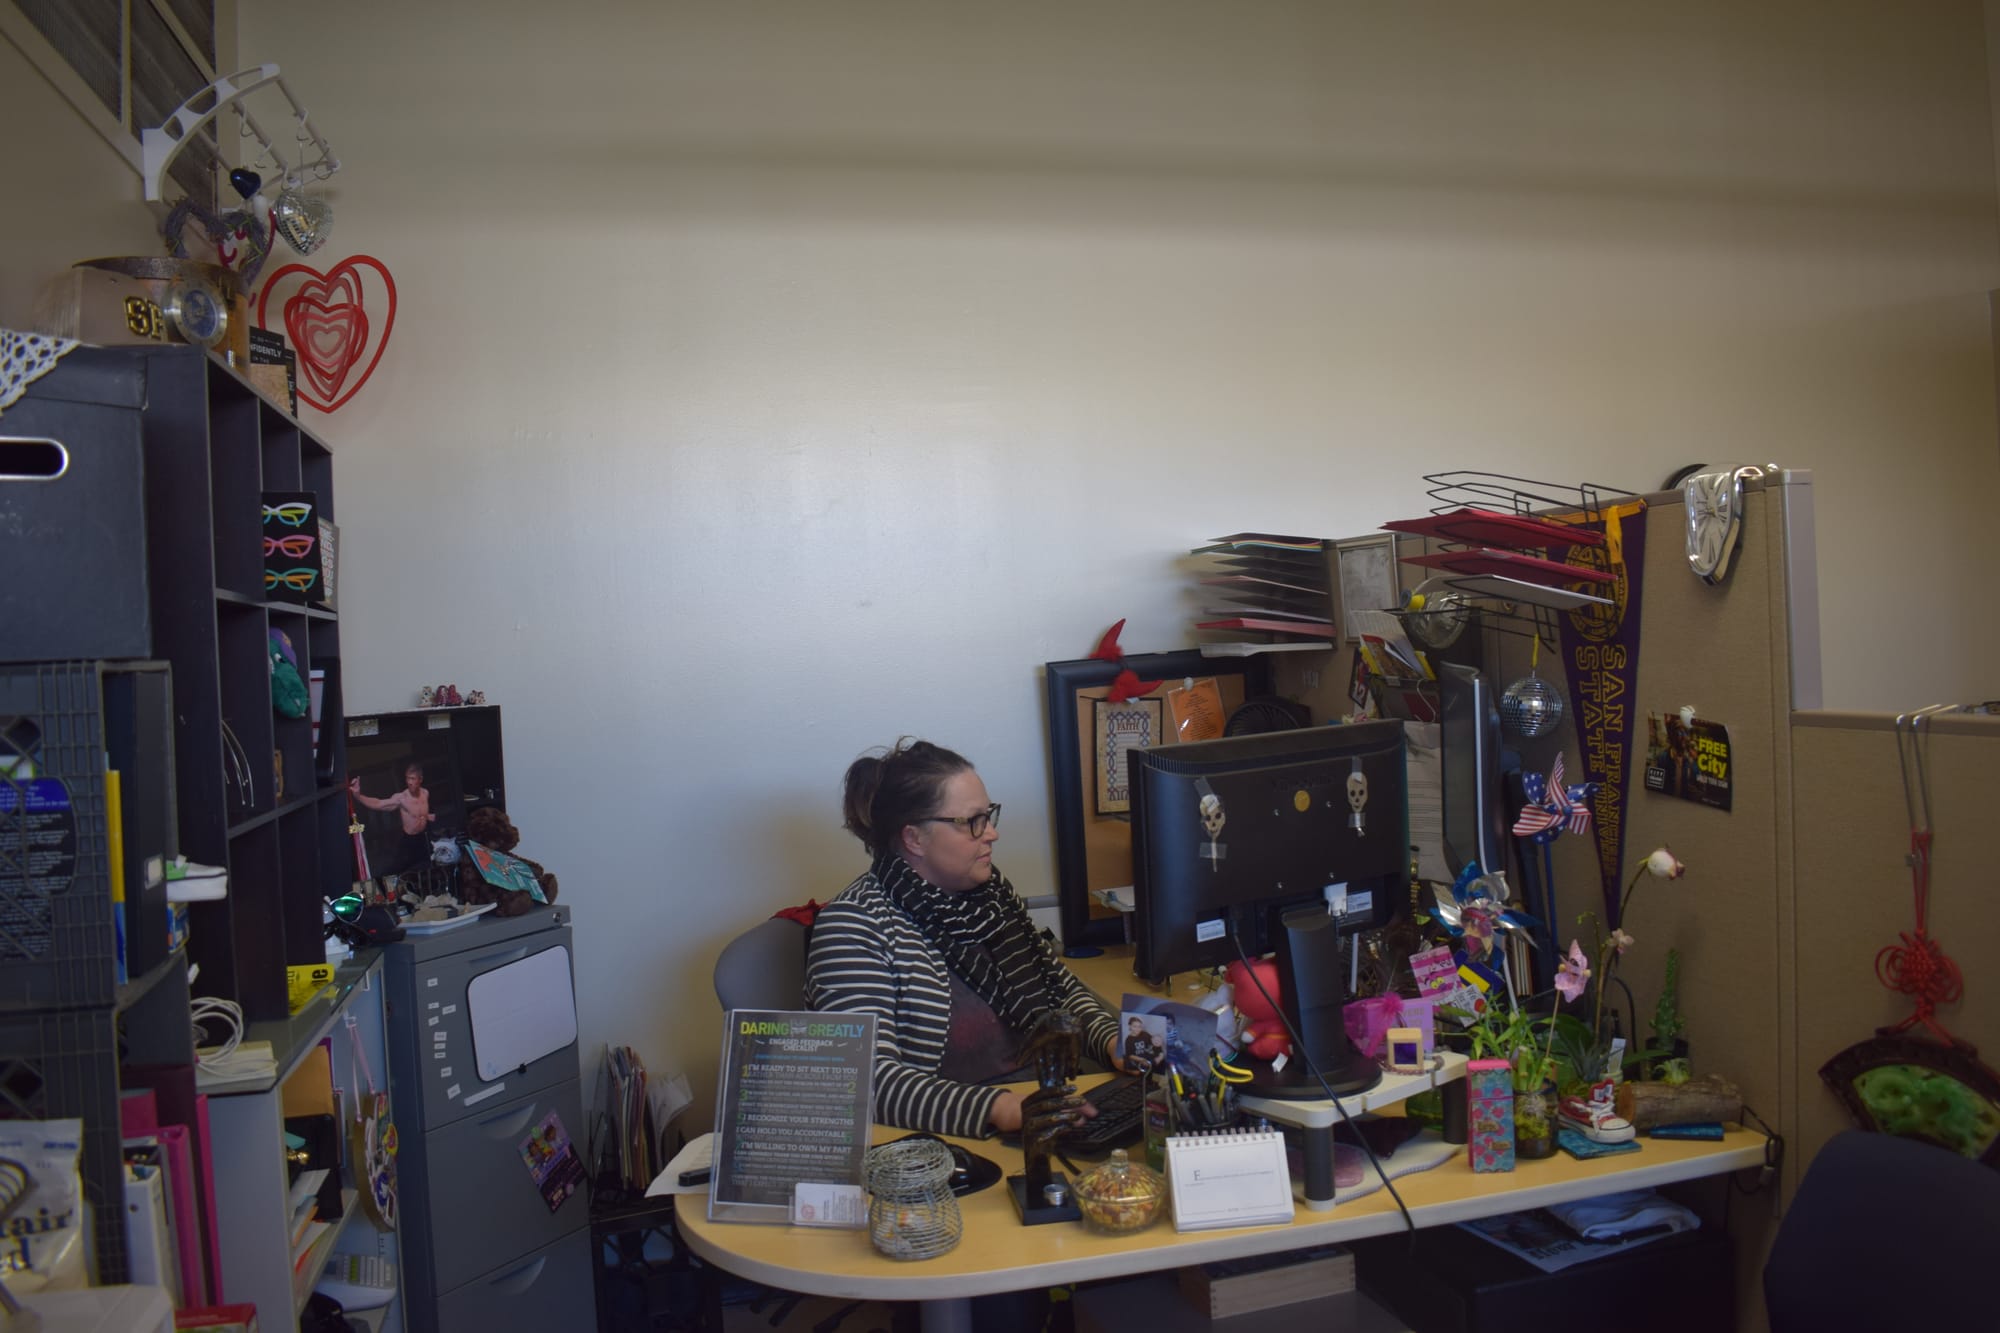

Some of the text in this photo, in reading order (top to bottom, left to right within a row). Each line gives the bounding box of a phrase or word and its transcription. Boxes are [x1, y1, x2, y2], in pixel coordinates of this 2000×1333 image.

[1600, 643, 1626, 733] SAN
[1575, 643, 1604, 773] STATE
[1116, 722, 1139, 732] FAITH
[1698, 738, 1728, 758] FREE
[1697, 754, 1728, 779] City
[740, 1021, 790, 1036] DARING
[807, 1023, 865, 1038] GREATLY
[786, 1065, 795, 1073] TO
[810, 1066, 829, 1074] NEXT
[757, 1127, 776, 1135] HOLD
[778, 1128, 793, 1136] YOU
[754, 1142, 786, 1151] WILLING
[833, 1146, 852, 1154] PART
